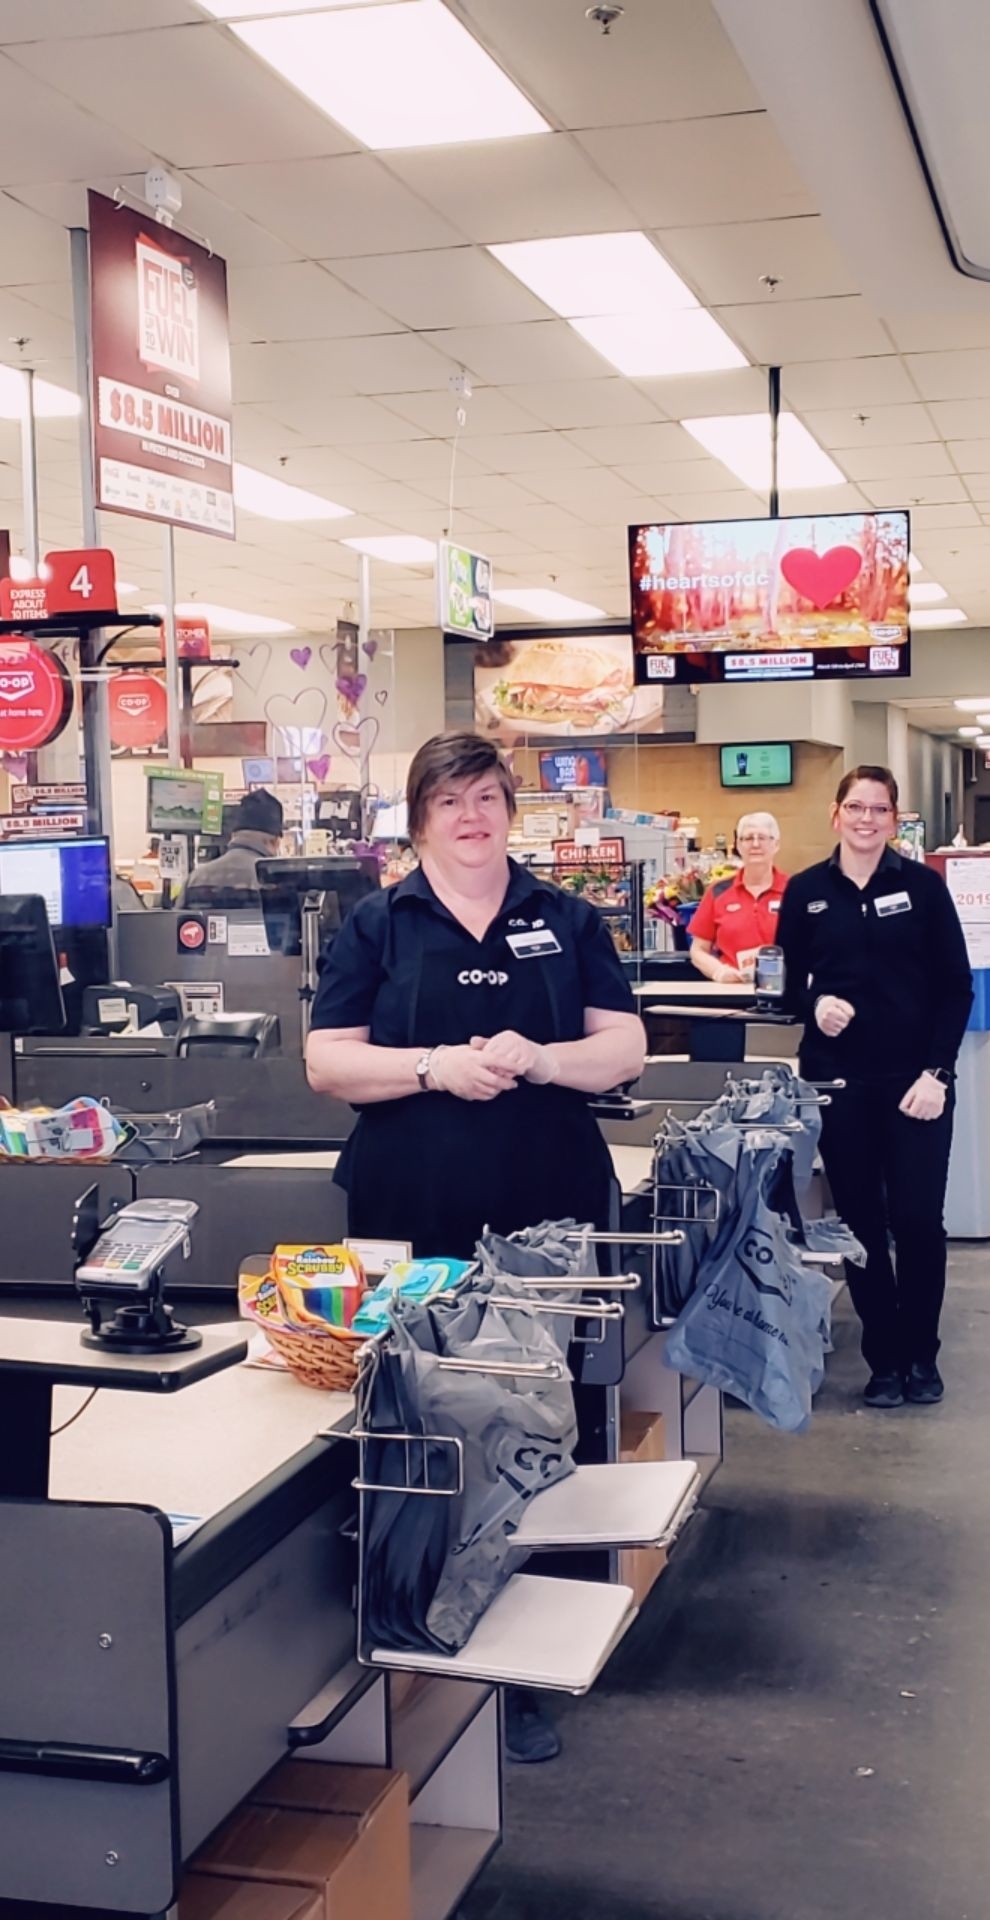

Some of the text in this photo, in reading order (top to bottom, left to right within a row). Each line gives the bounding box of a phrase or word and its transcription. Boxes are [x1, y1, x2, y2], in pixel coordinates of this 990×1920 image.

[143, 258, 193, 329] FUEL
[155, 315, 195, 366] WIN
[110, 388, 153, 431] $8.5
[157, 404, 224, 455] MILLION
[70, 565, 93, 598] 4
[639, 570, 769, 592] #heartsofdc
[10, 588, 46, 600] EXPRESS
[13, 599, 44, 610] ABOUT
[12, 609, 48, 619] 10 ITEMS
[759, 655, 807, 665] MILLION
[0, 677, 28, 688] O-OP
[32, 817, 79, 826] MILLION
[559, 845, 617, 860] CHICKEN
[457, 969, 509, 986] CO-OP
